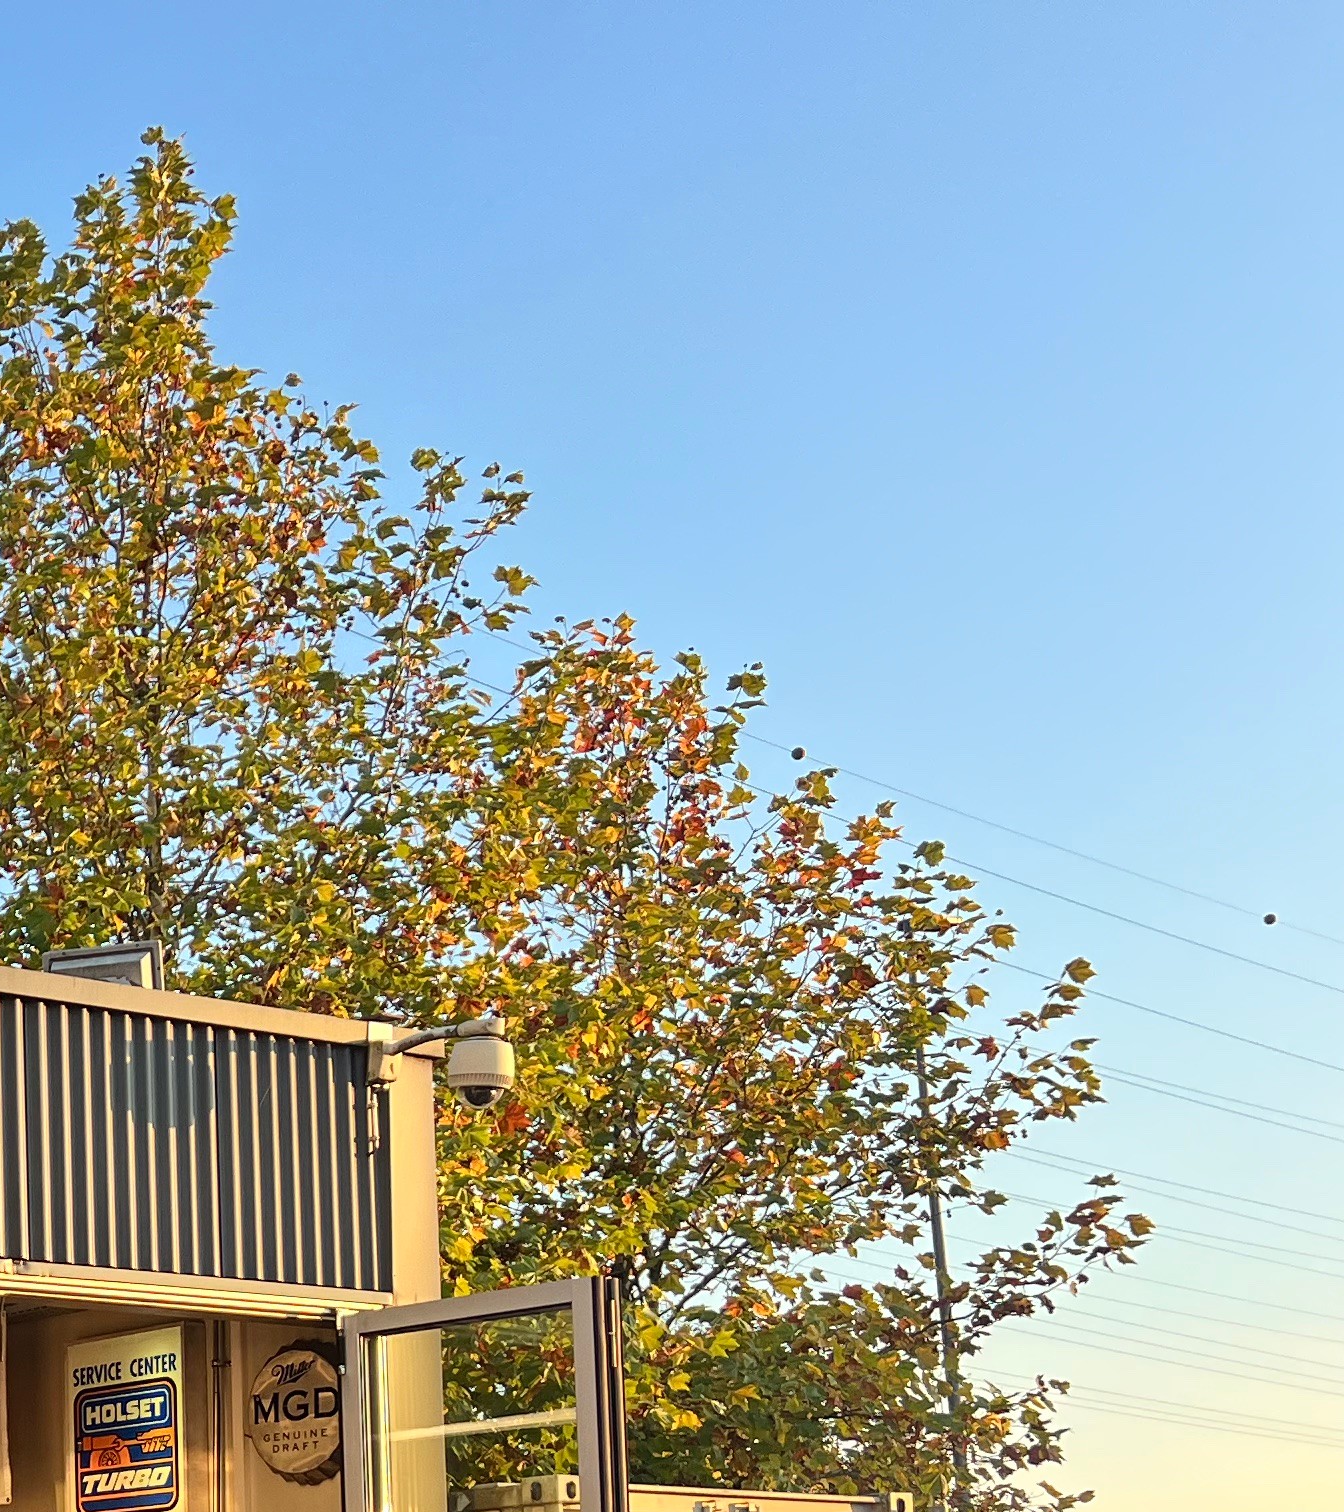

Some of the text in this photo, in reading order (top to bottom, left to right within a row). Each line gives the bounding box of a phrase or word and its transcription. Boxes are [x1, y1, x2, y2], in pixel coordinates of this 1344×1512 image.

[73, 1353, 177, 1388] SERVICE CENTER
[272, 1358, 318, 1385] Miller
[85, 1396, 166, 1427] HOLSET
[253, 1387, 340, 1426] MGD
[263, 1428, 329, 1443] GENUINE
[273, 1441, 320, 1454] DRAFT
[82, 1465, 172, 1496] TURBO
